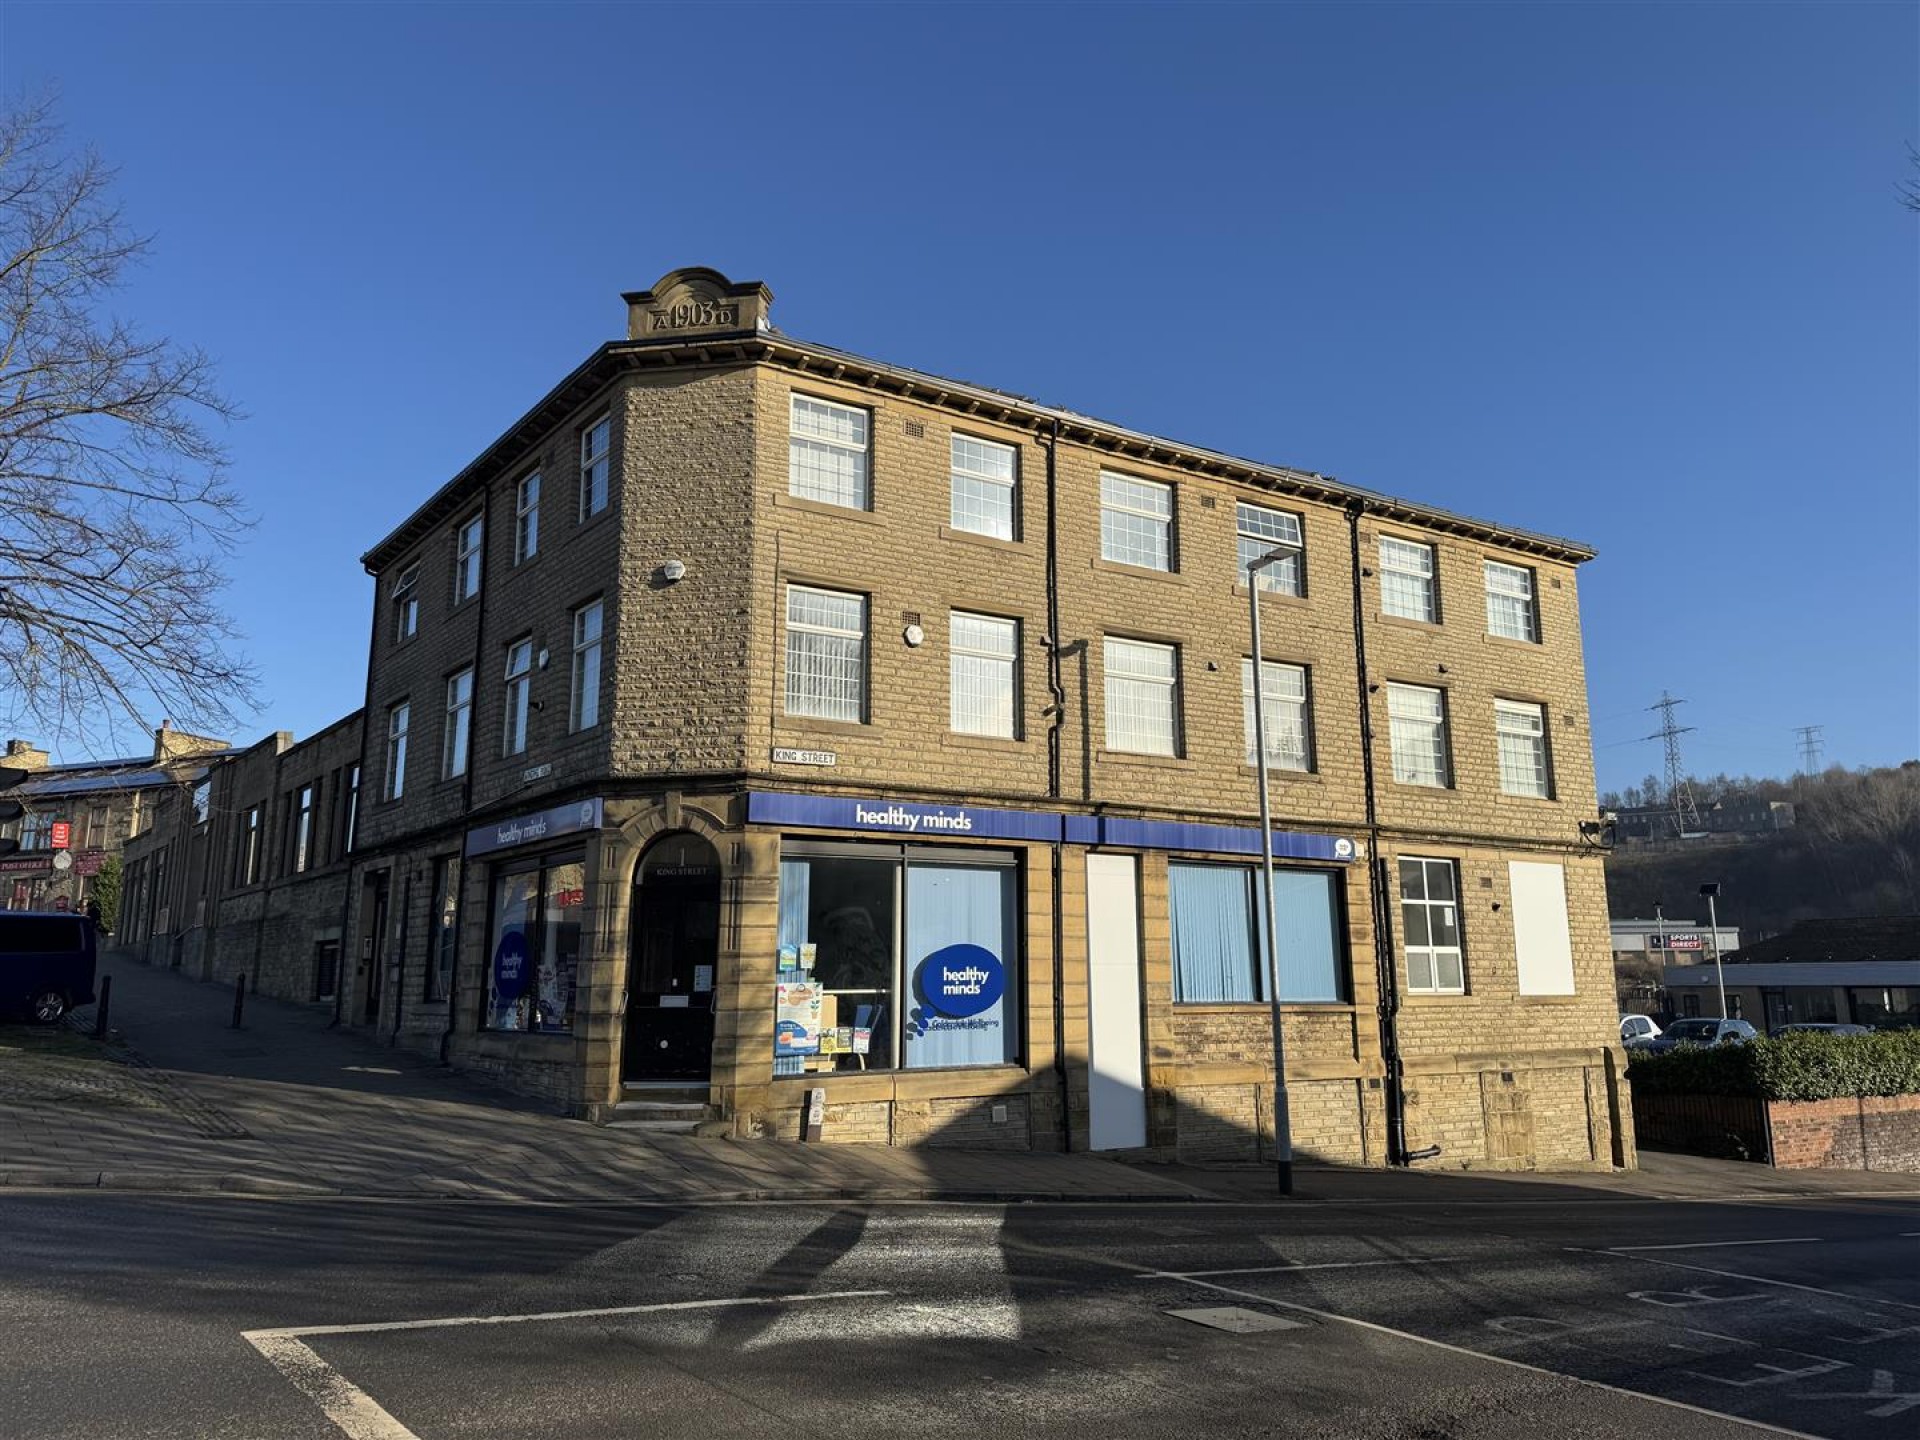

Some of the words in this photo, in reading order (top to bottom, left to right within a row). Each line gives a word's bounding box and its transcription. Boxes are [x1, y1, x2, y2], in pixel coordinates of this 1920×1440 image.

[675, 300, 716, 328] 1903
[775, 750, 797, 761] KING
[801, 752, 834, 764] STREET
[855, 803, 920, 832] healthy
[923, 810, 972, 830] minds
[497, 823, 523, 844] healthy
[523, 816, 547, 839] minds
[656, 867, 677, 876] KING
[678, 867, 707, 876] STREET
[1671, 940, 1698, 948] DIRECT
[943, 966, 990, 985] healthy
[943, 980, 981, 995] minds
